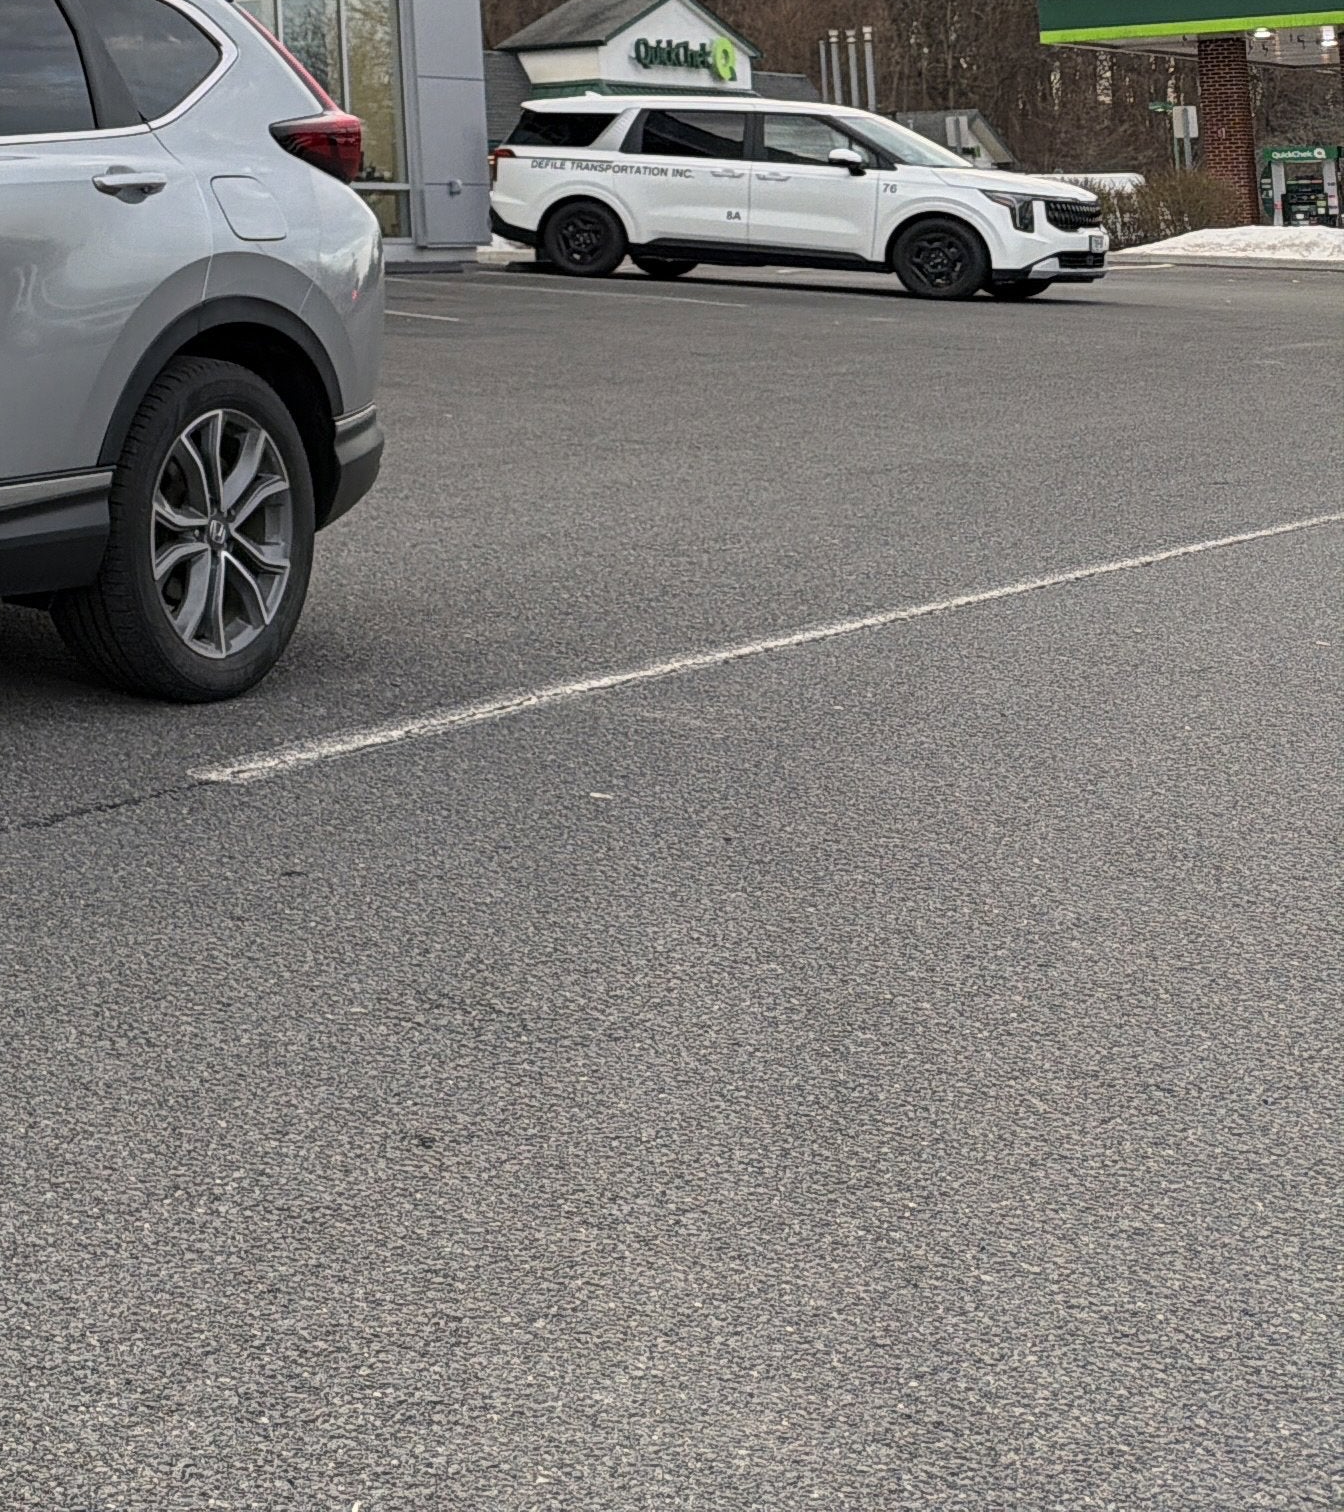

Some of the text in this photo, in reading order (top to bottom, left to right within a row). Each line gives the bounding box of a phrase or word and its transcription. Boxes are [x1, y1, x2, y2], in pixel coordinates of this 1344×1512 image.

[530, 159, 695, 178] DEFILE TRANSPORTATION INC.
[882, 183, 897, 193] 76
[726, 211, 741, 221] 8A
